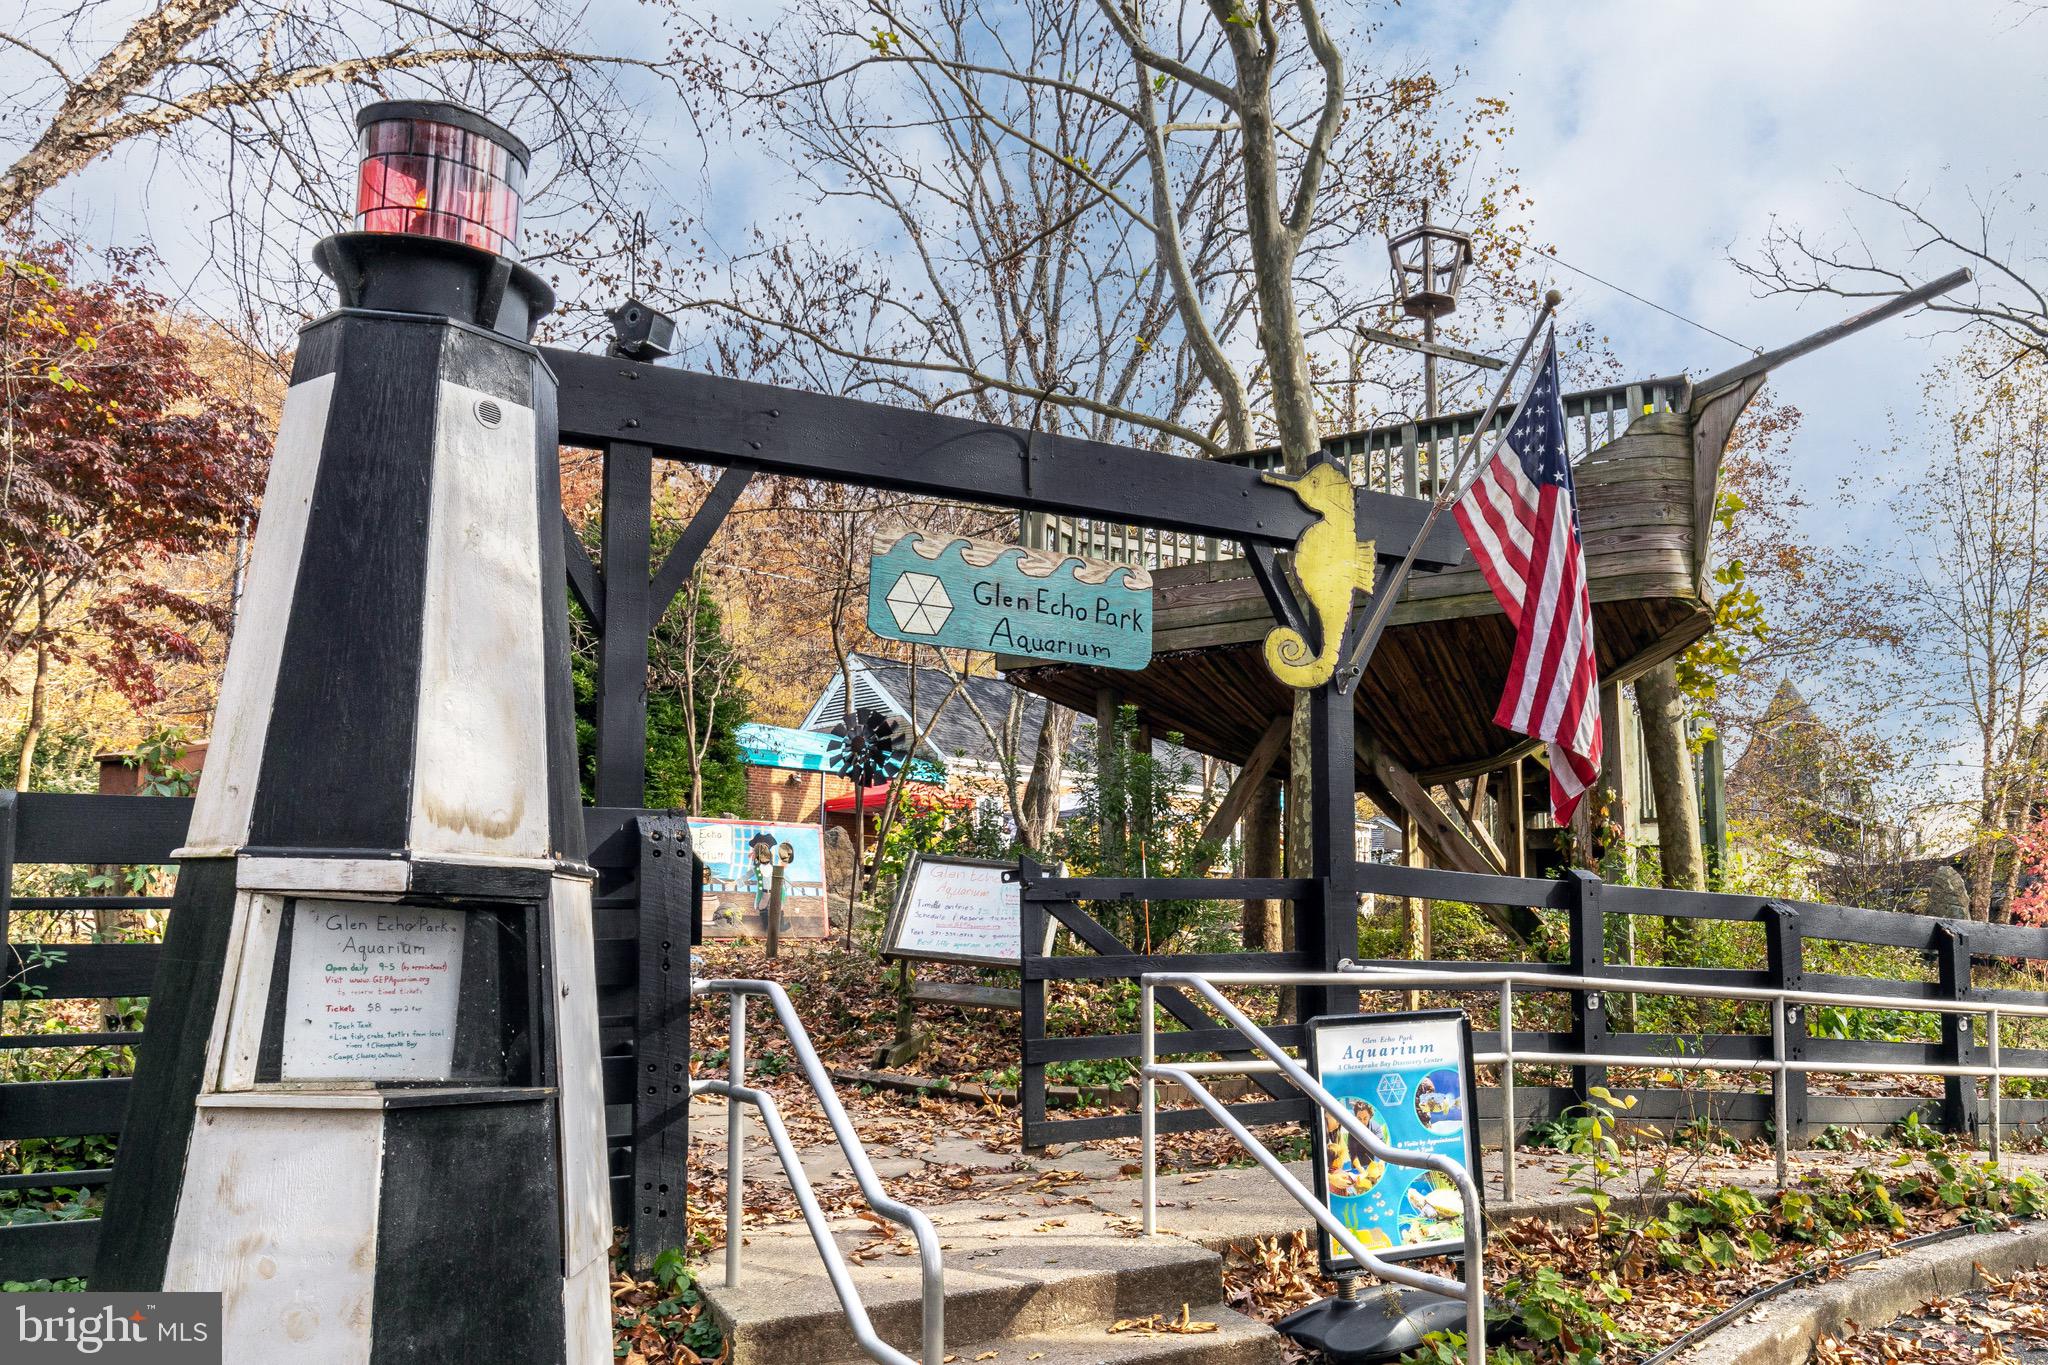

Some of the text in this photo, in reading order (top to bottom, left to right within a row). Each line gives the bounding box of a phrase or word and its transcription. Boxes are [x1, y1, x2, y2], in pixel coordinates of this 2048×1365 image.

[973, 581, 1143, 632] Glen Echo Park
[989, 617, 1111, 658] Aquarium
[936, 882, 989, 898] Aquarium
[326, 914, 448, 932] Glen Echo Park
[342, 936, 425, 962] Aquarium
[325, 963, 348, 974] Open
[350, 963, 369, 974] daily
[378, 962, 396, 971] 9-5
[325, 975, 343, 984] Visit
[326, 1004, 355, 1013] Tickets
[367, 1002, 382, 1013] $8
[406, 1040, 418, 1049] Bay
[1342, 1042, 1434, 1062] Aquarium
[1343, 1061, 1378, 1071] Chesapeake
[1379, 1060, 1391, 1068] Bay
[1392, 1059, 1422, 1067] Discovery
